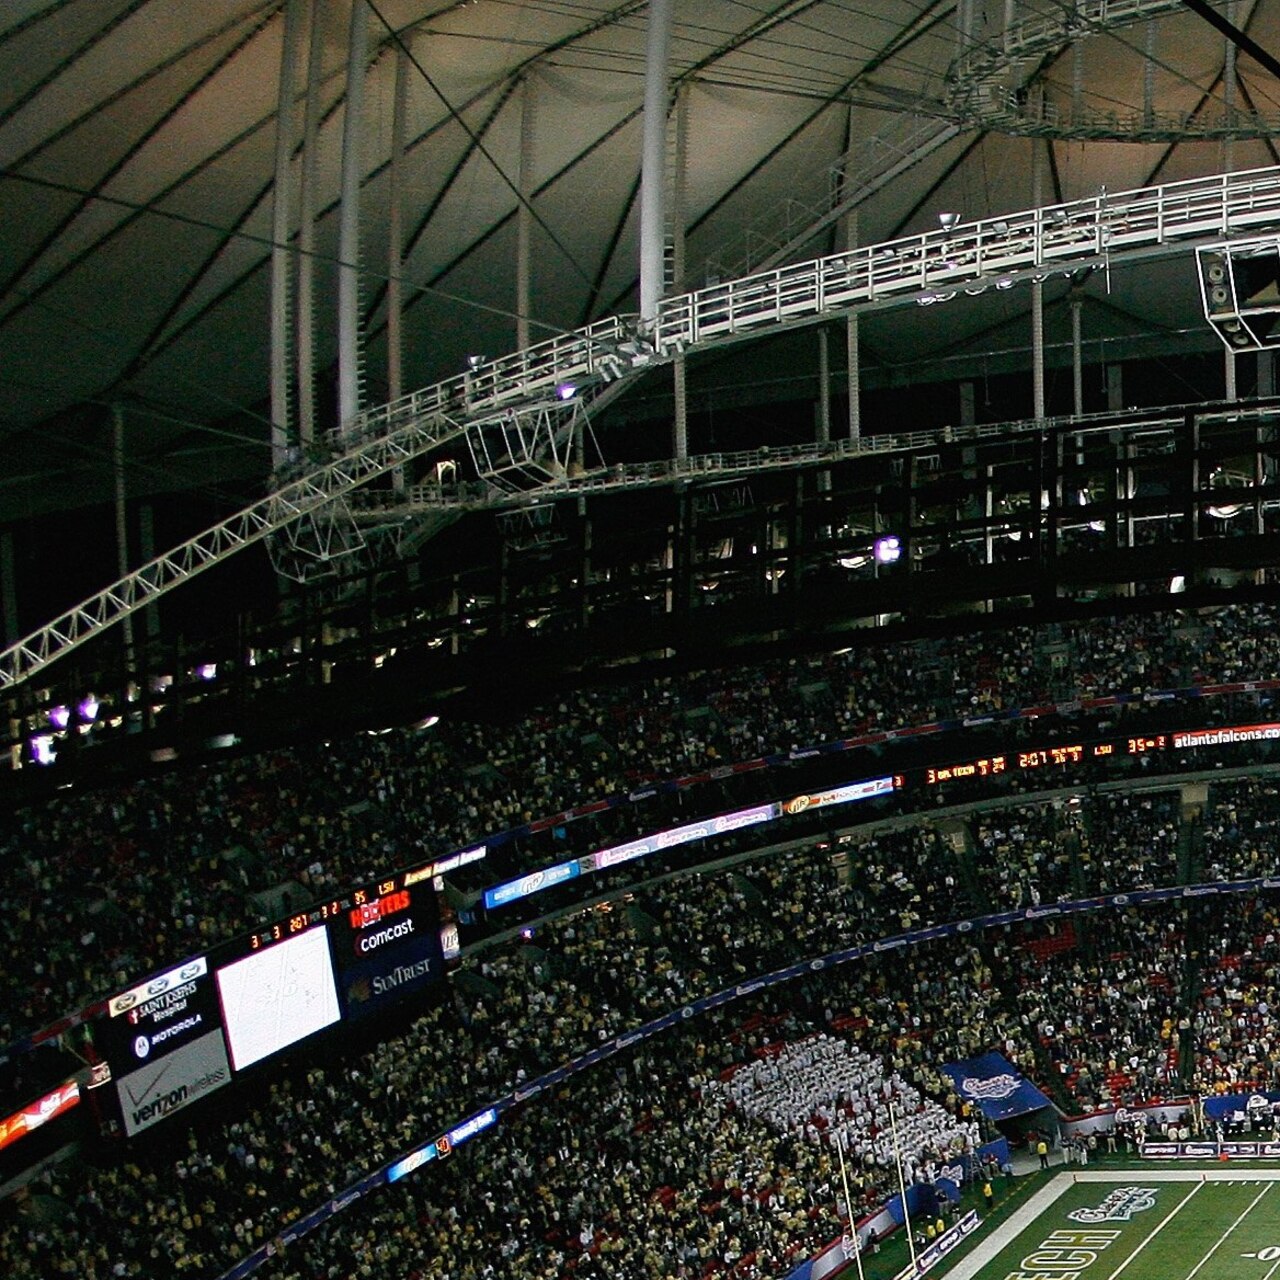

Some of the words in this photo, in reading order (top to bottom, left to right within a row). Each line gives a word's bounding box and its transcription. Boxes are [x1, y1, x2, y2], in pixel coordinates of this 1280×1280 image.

[1128, 739, 1145, 754] 35
[1019, 751, 1047, 768] 2:07
[251, 935, 259, 949] 3
[360, 918, 414, 952] comcast
[152, 998, 188, 1023] Hospital
[151, 1014, 202, 1046] MOTOROLA
[132, 1084, 188, 1126] verizon
